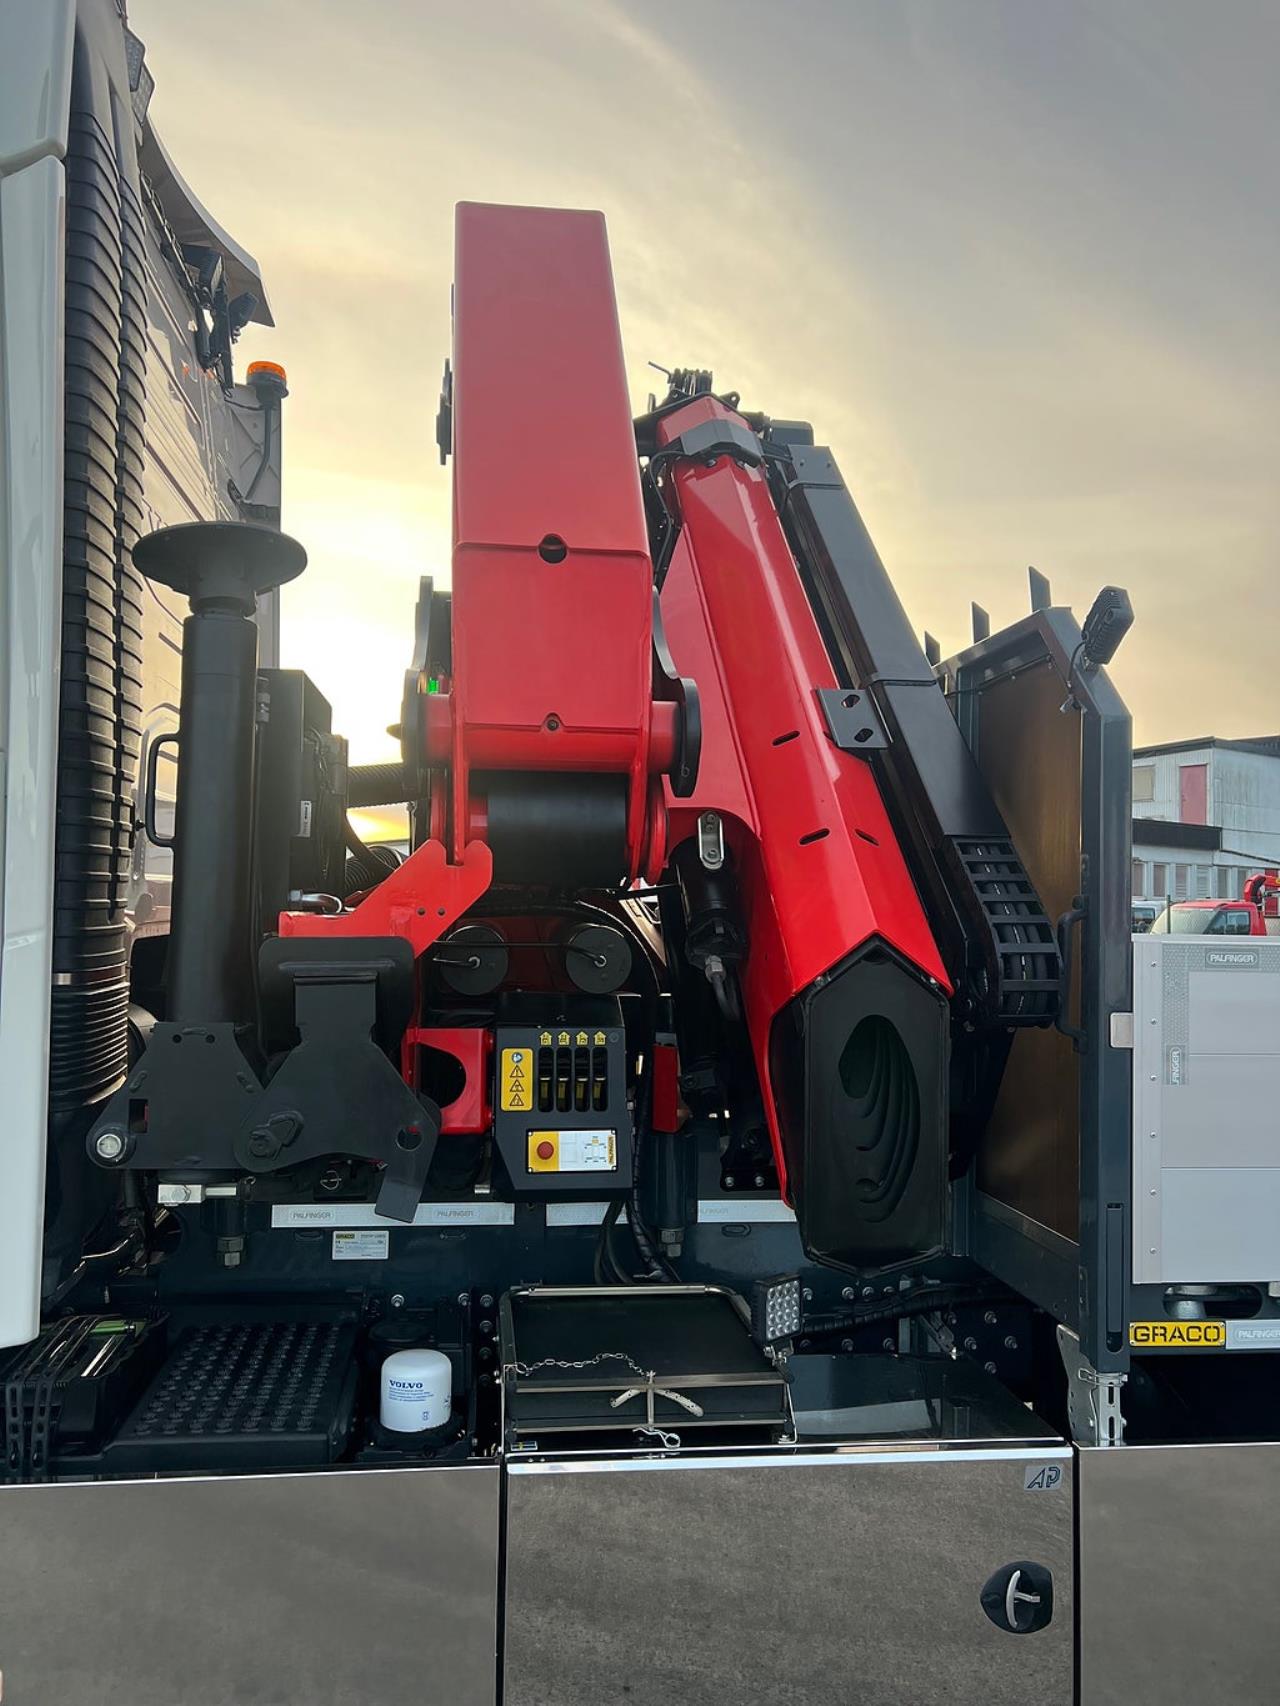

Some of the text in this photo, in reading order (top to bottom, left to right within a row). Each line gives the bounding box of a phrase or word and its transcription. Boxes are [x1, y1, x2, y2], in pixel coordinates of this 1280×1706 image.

[1209, 953, 1254, 963] PALFINGER
[292, 1211, 331, 1219] PALFINGER
[1133, 1325, 1221, 1342] GRACO
[389, 1380, 424, 1389] VOLVO
[1027, 1466, 1061, 1489] AP
